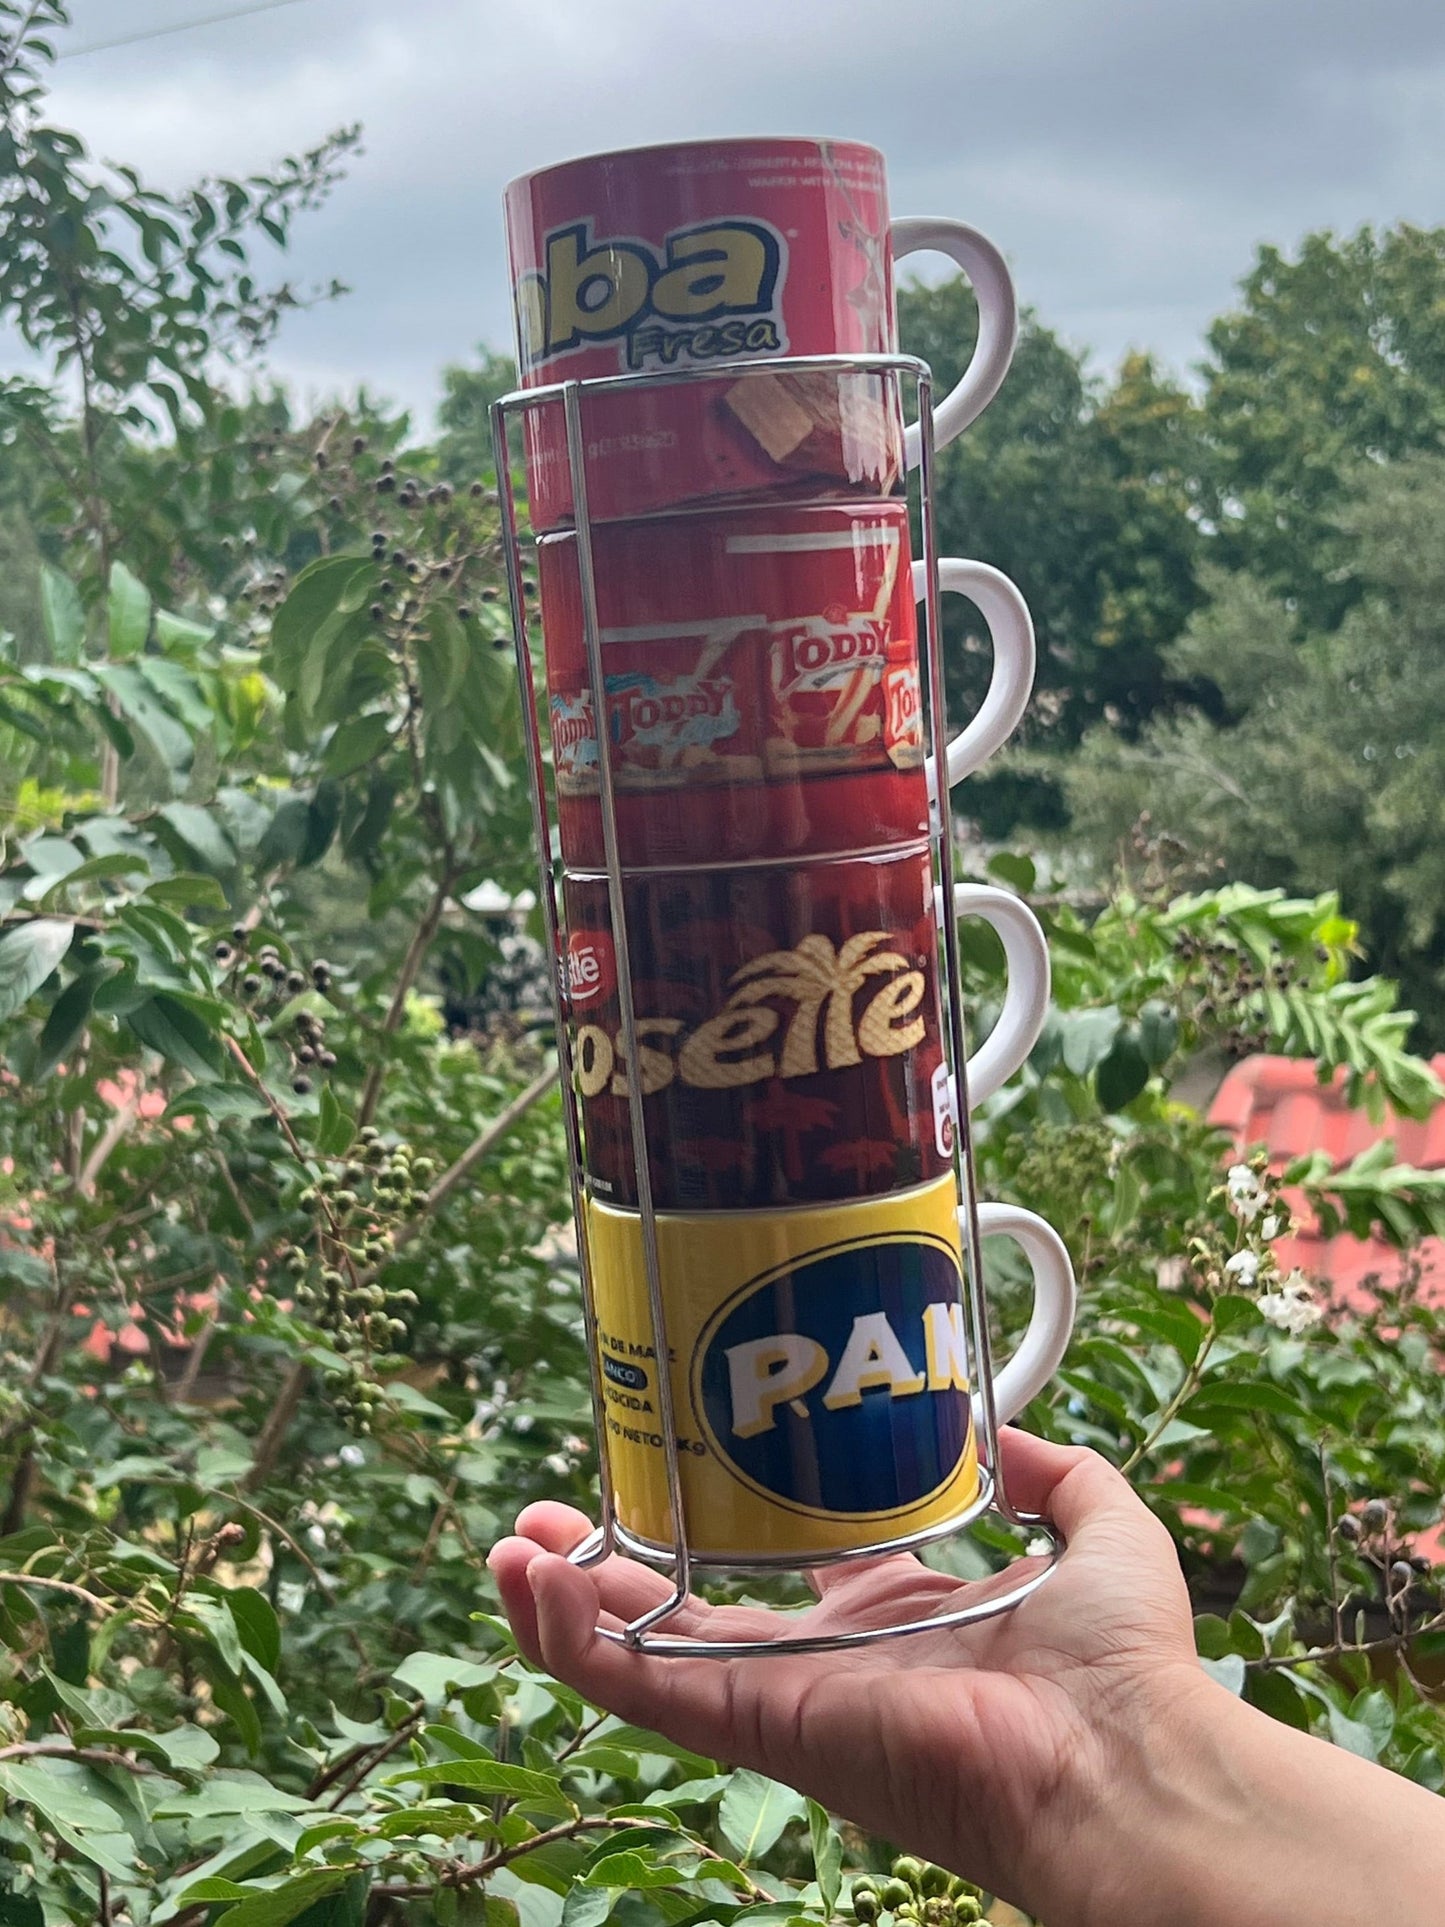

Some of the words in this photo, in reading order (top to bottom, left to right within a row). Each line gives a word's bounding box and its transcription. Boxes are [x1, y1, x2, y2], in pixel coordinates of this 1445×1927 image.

[627, 318, 781, 370] Fresa
[767, 618, 892, 690] TODDY
[623, 1425, 663, 1448] NETO
